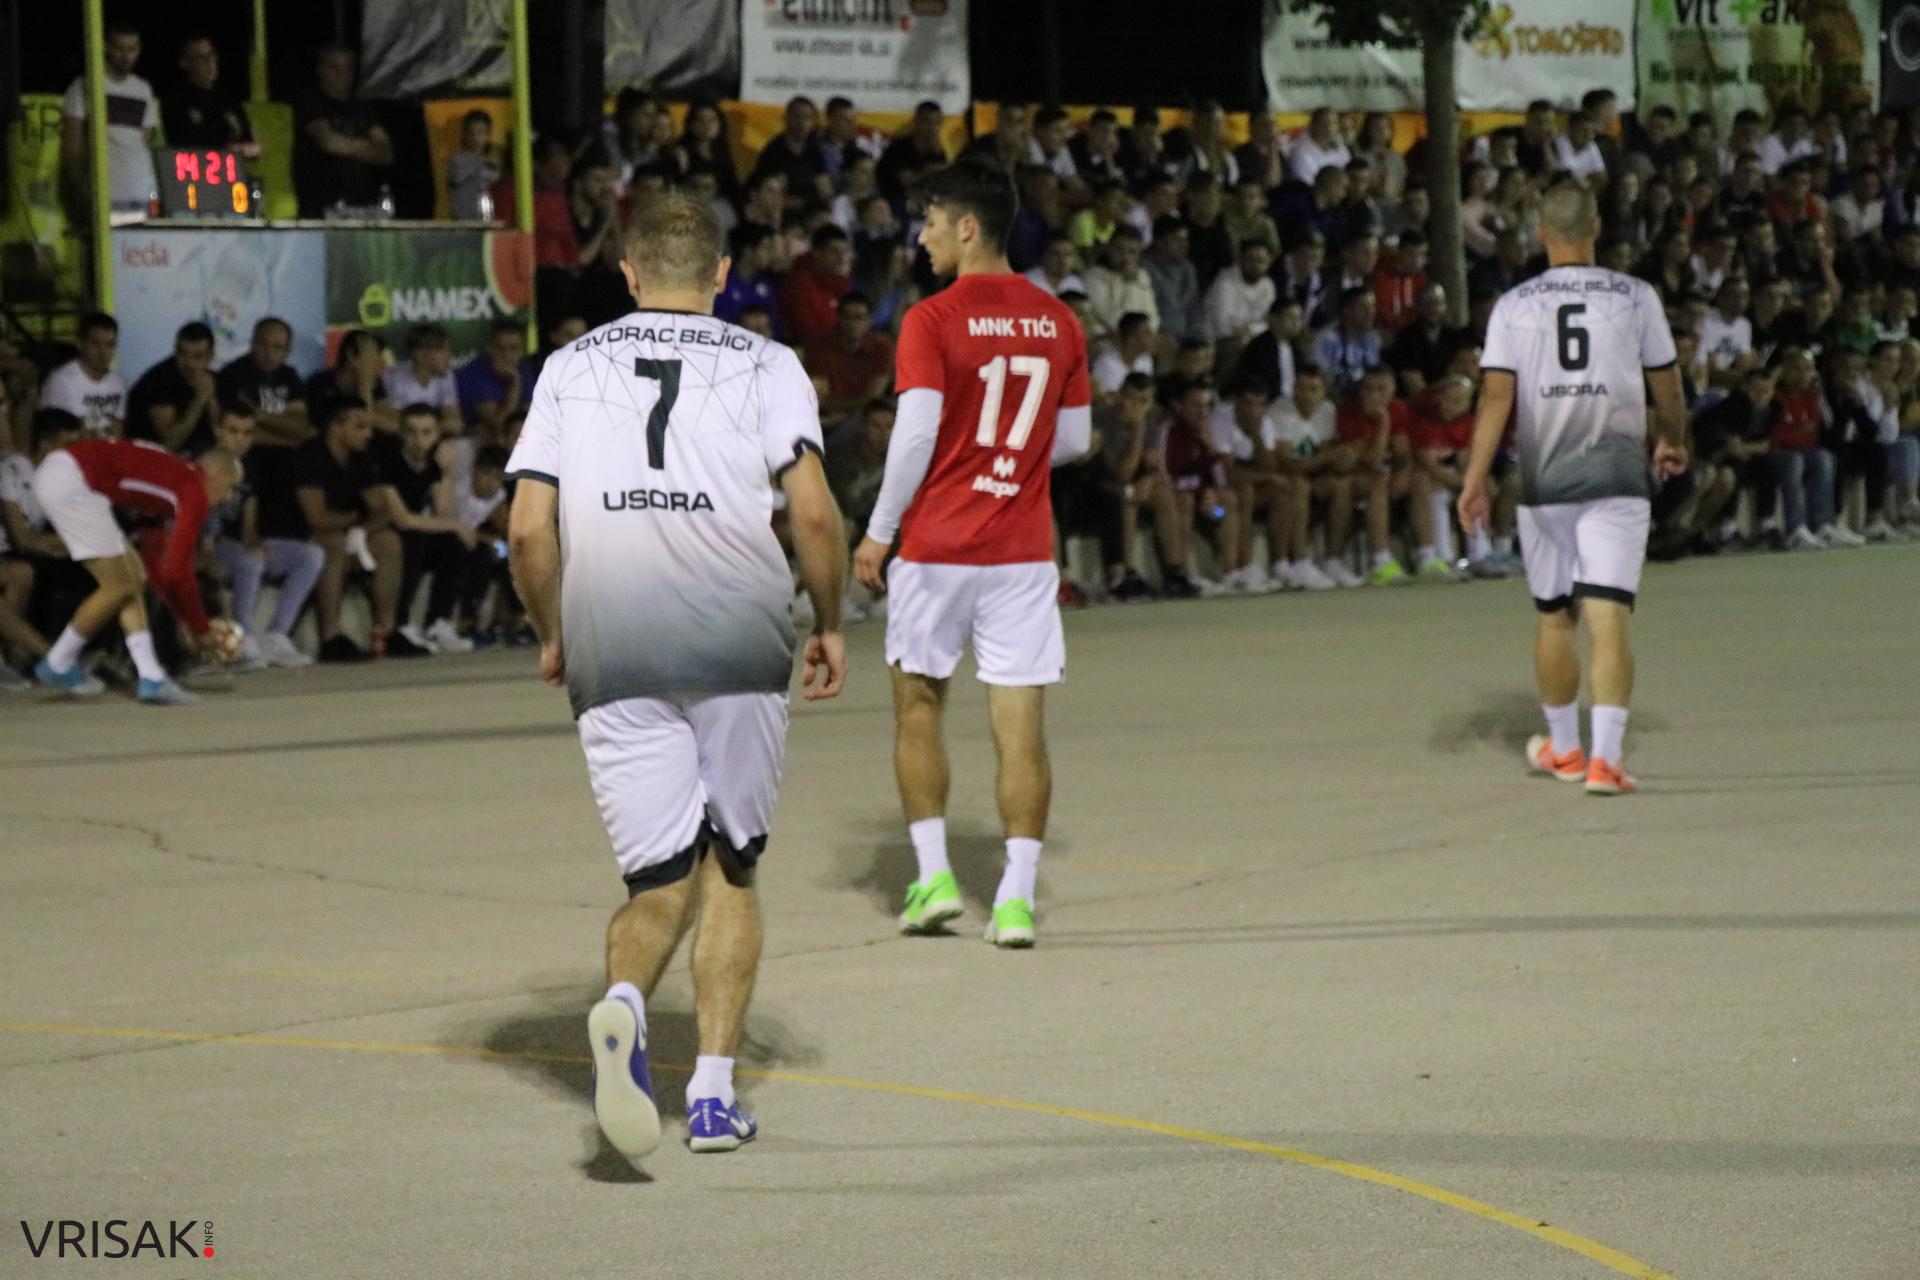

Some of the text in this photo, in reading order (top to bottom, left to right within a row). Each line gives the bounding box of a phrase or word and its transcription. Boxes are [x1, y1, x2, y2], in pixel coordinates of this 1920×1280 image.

[205, 150, 237, 185] 21
[231, 181, 249, 213] 0
[391, 285, 495, 322] NAMEX
[574, 326, 676, 352] DVORAC
[967, 315, 1058, 339] MNK TIĆI
[1557, 303, 1590, 373] 6
[634, 356, 683, 471] 7
[975, 355, 1051, 451] 17
[602, 488, 716, 513] USORA
